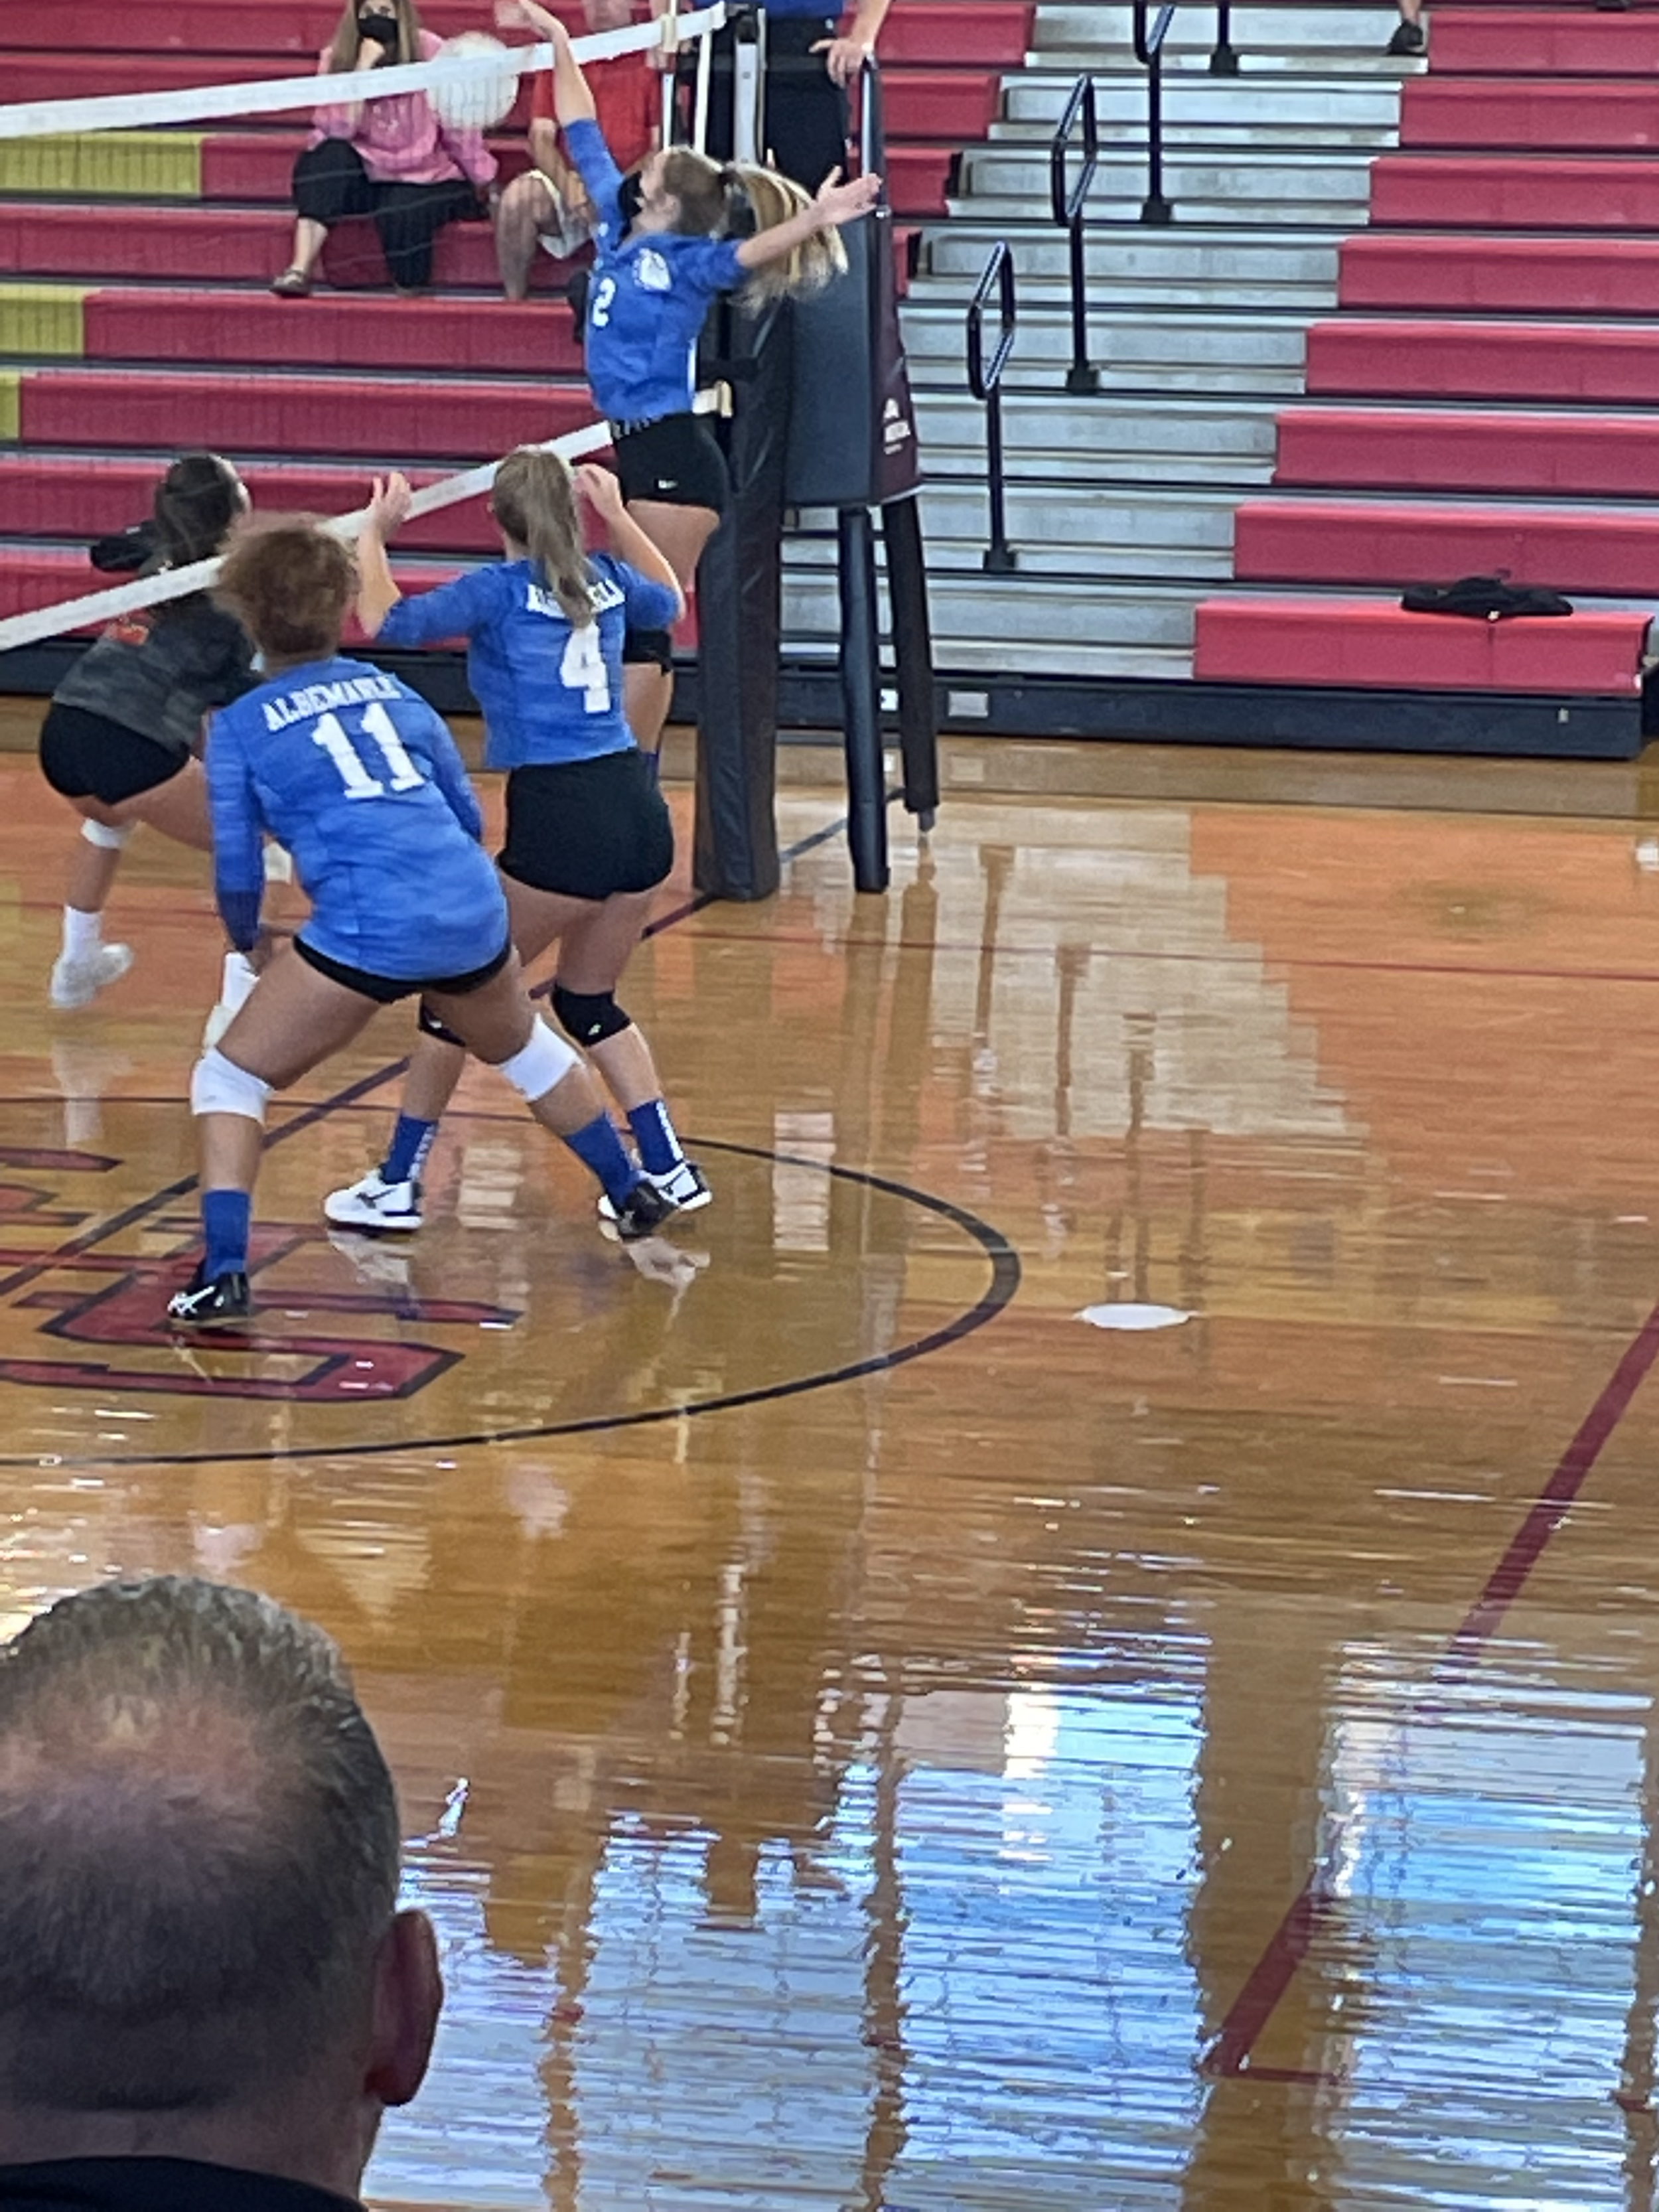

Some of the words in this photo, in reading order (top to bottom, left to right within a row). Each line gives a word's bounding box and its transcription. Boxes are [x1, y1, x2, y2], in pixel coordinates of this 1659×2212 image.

[593, 277, 616, 327] 2
[559, 621, 611, 713] 4
[311, 702, 425, 798] 11
